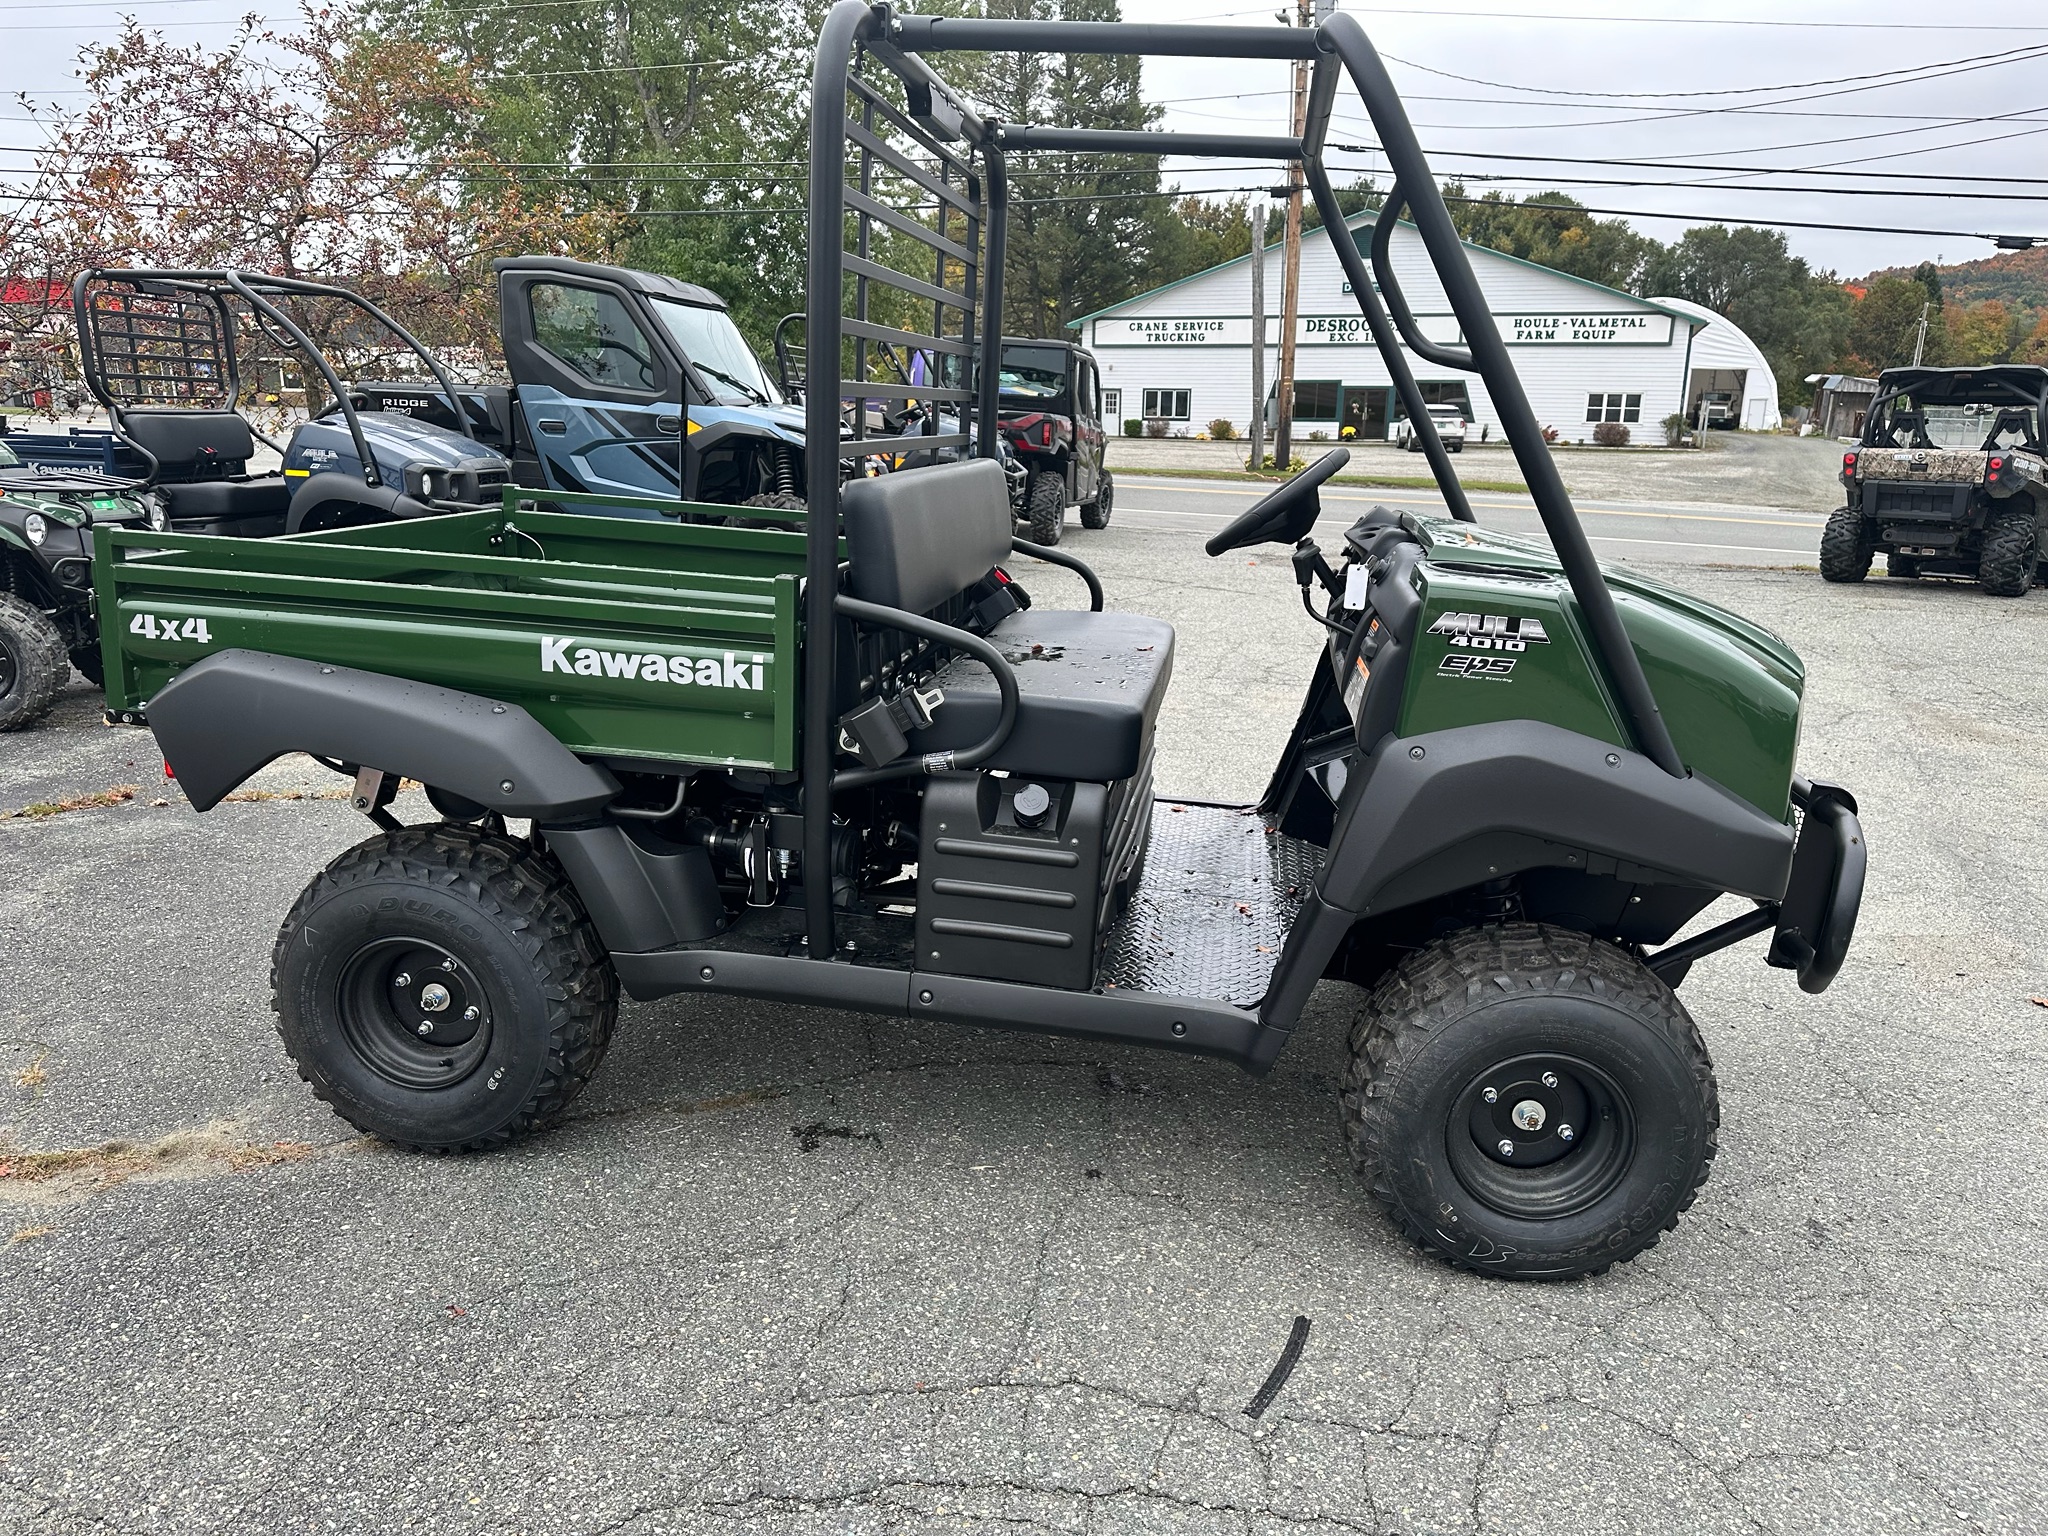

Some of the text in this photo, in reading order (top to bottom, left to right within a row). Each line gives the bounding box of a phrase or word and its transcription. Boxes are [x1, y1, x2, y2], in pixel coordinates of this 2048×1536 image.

[1129, 321, 1224, 331] CRANE SERVICE
[1306, 319, 1417, 332] DESROC
[1146, 333, 1205, 342] TRUCKING
[1328, 333, 1358, 342] EXC.
[1516, 330, 1616, 340] FARM EQUIP
[382, 398, 429, 407] RIDGE
[302, 448, 339, 460] MULE
[130, 613, 213, 644] 4x4
[1426, 611, 1552, 644] MULE
[1449, 636, 1526, 652] 4010
[541, 636, 764, 691] Kawasaki
[377, 897, 482, 942] DURO
